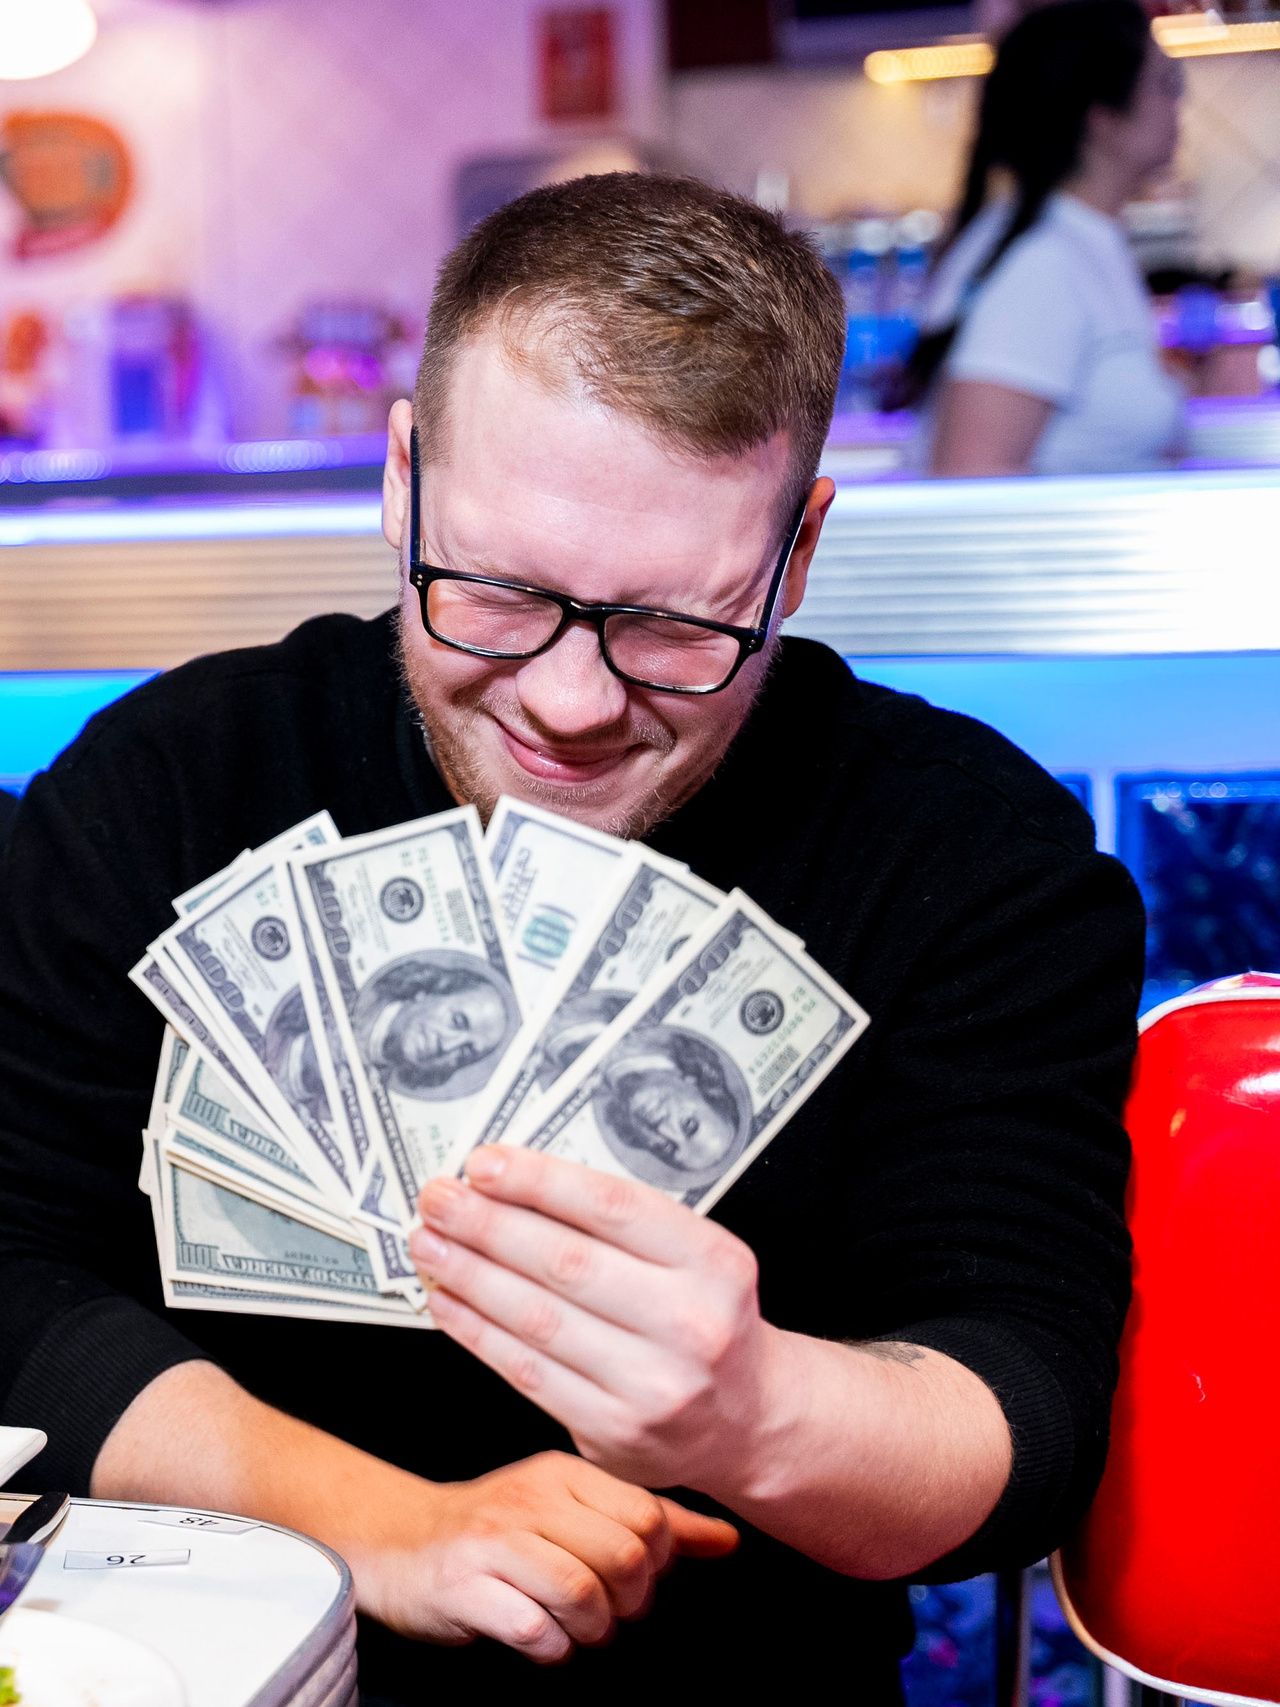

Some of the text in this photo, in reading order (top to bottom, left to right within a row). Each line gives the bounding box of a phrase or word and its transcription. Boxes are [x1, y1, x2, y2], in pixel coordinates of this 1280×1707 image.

[311, 877, 352, 959] 100
[677, 921, 742, 996] 100
[186, 940, 244, 1009] 100
[177, 1242, 218, 1269] 100
[219, 1254, 307, 1279] AMERICA
[179, 1516, 219, 1526] 48
[106, 1554, 146, 1565] 26
